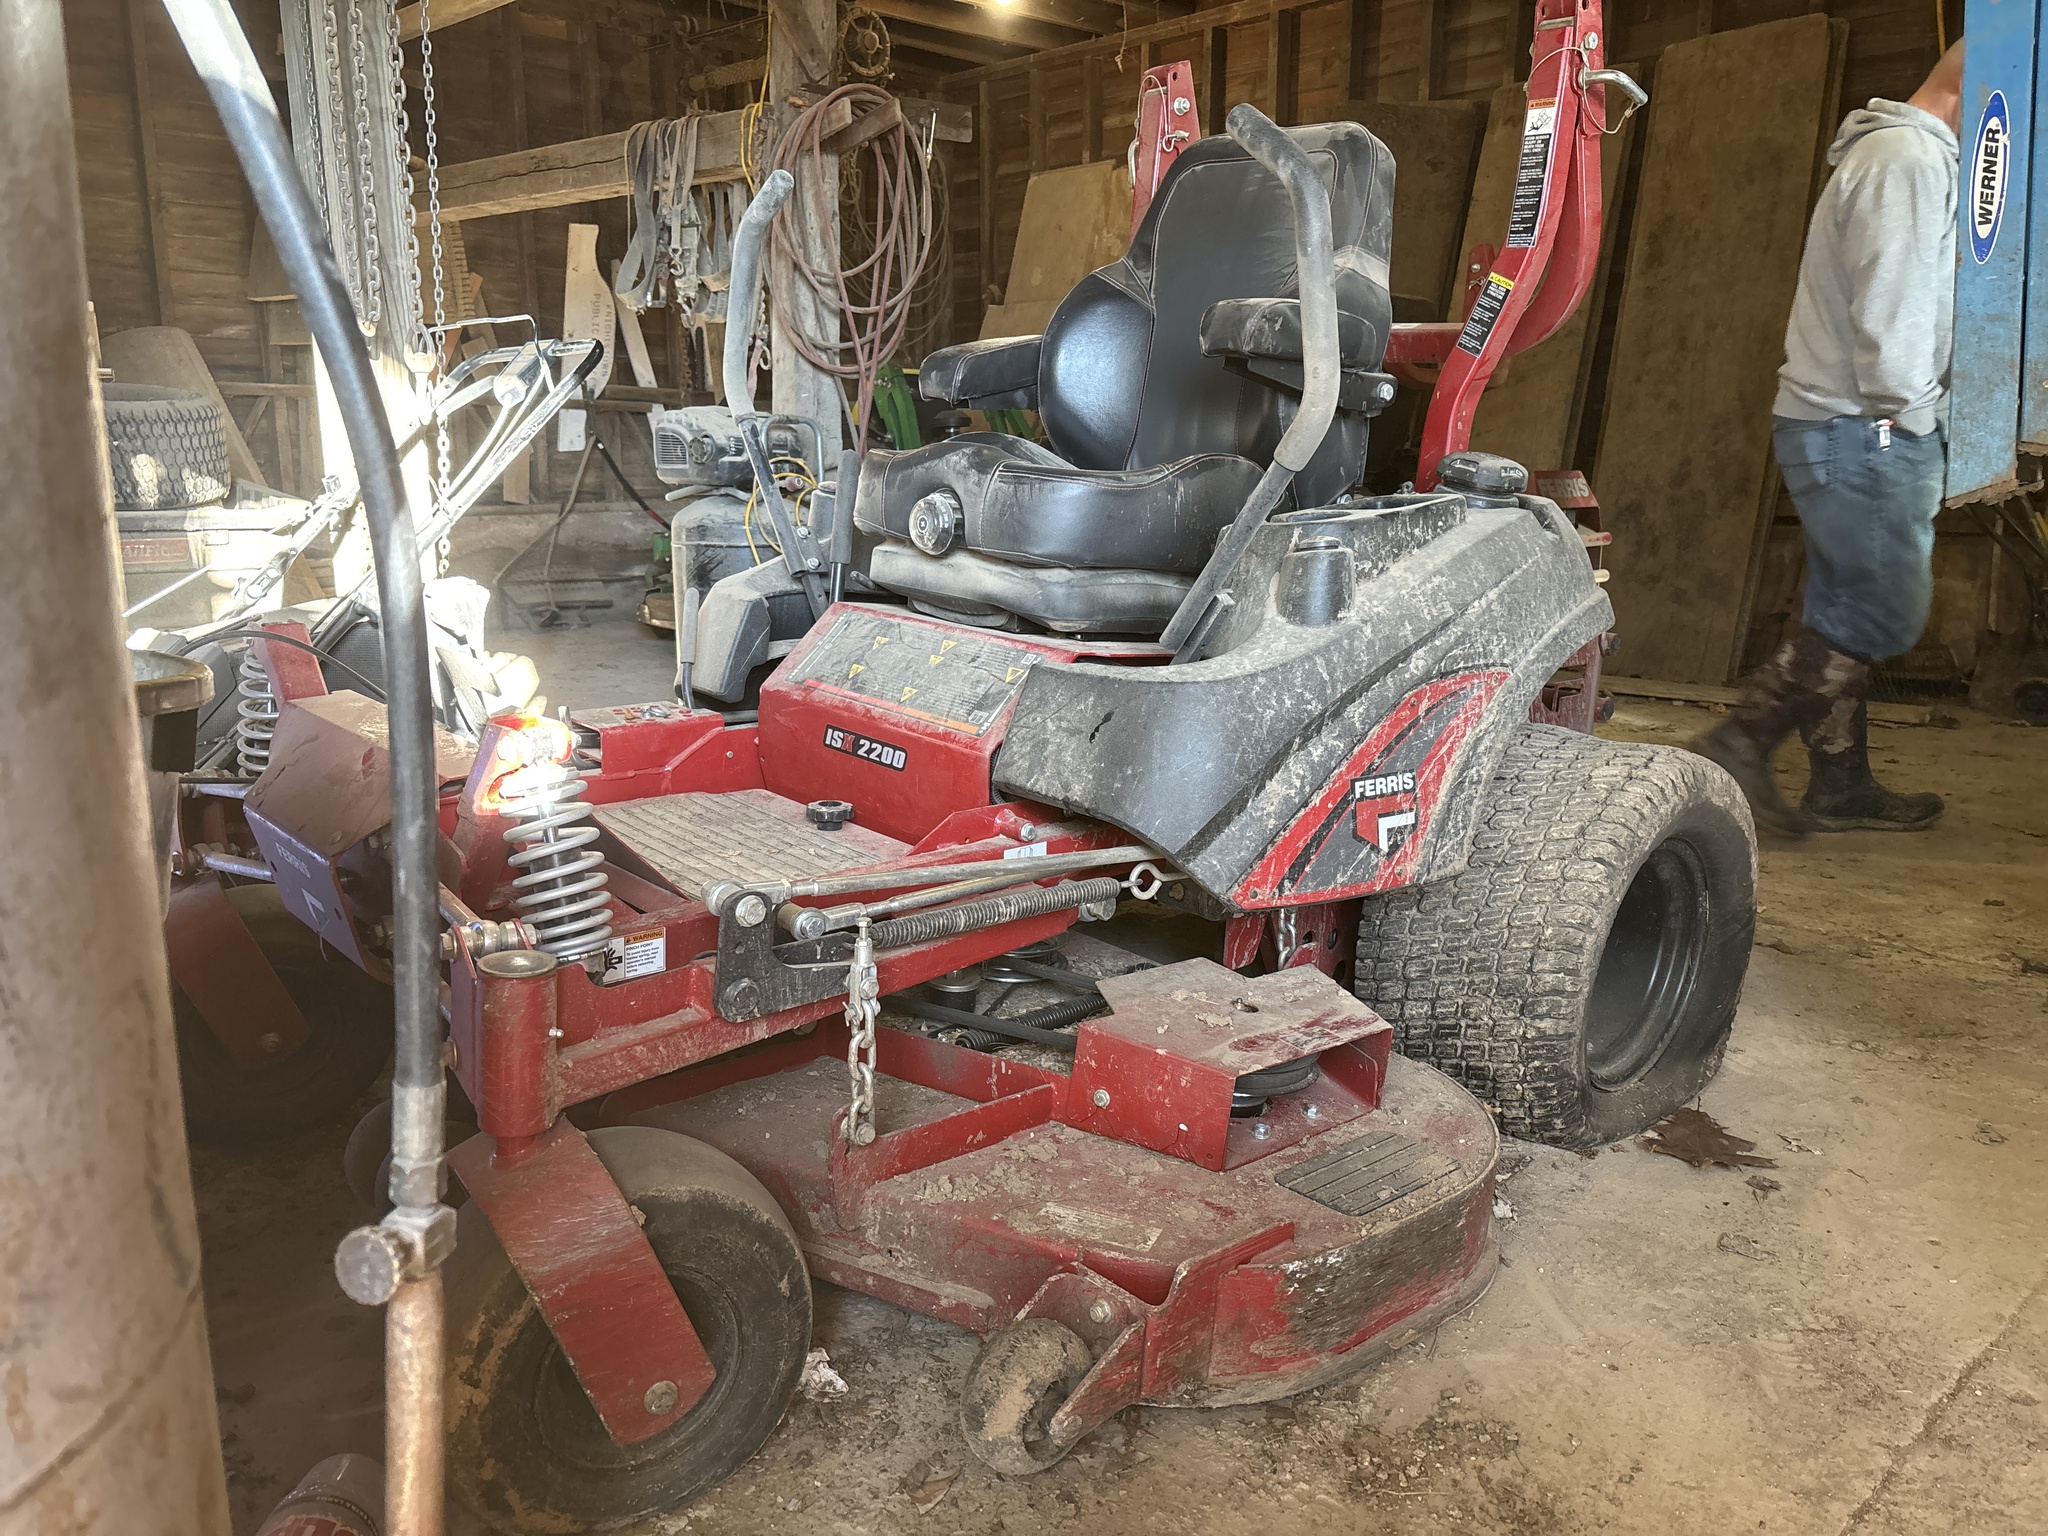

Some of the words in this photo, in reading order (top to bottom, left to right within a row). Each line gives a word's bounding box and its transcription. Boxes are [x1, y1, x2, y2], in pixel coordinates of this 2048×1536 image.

[1978, 127, 2000, 226] WERNER
[1494, 276, 1512, 288] CAUTION
[592, 293, 601, 334] PUBLIC
[1537, 477, 1590, 498] FERRIS
[825, 728, 855, 752] ISX
[857, 738, 906, 769] 2200
[1354, 772, 1414, 798] FERRIS
[275, 842, 311, 878] FERRIS
[633, 931, 663, 941] WARNING
